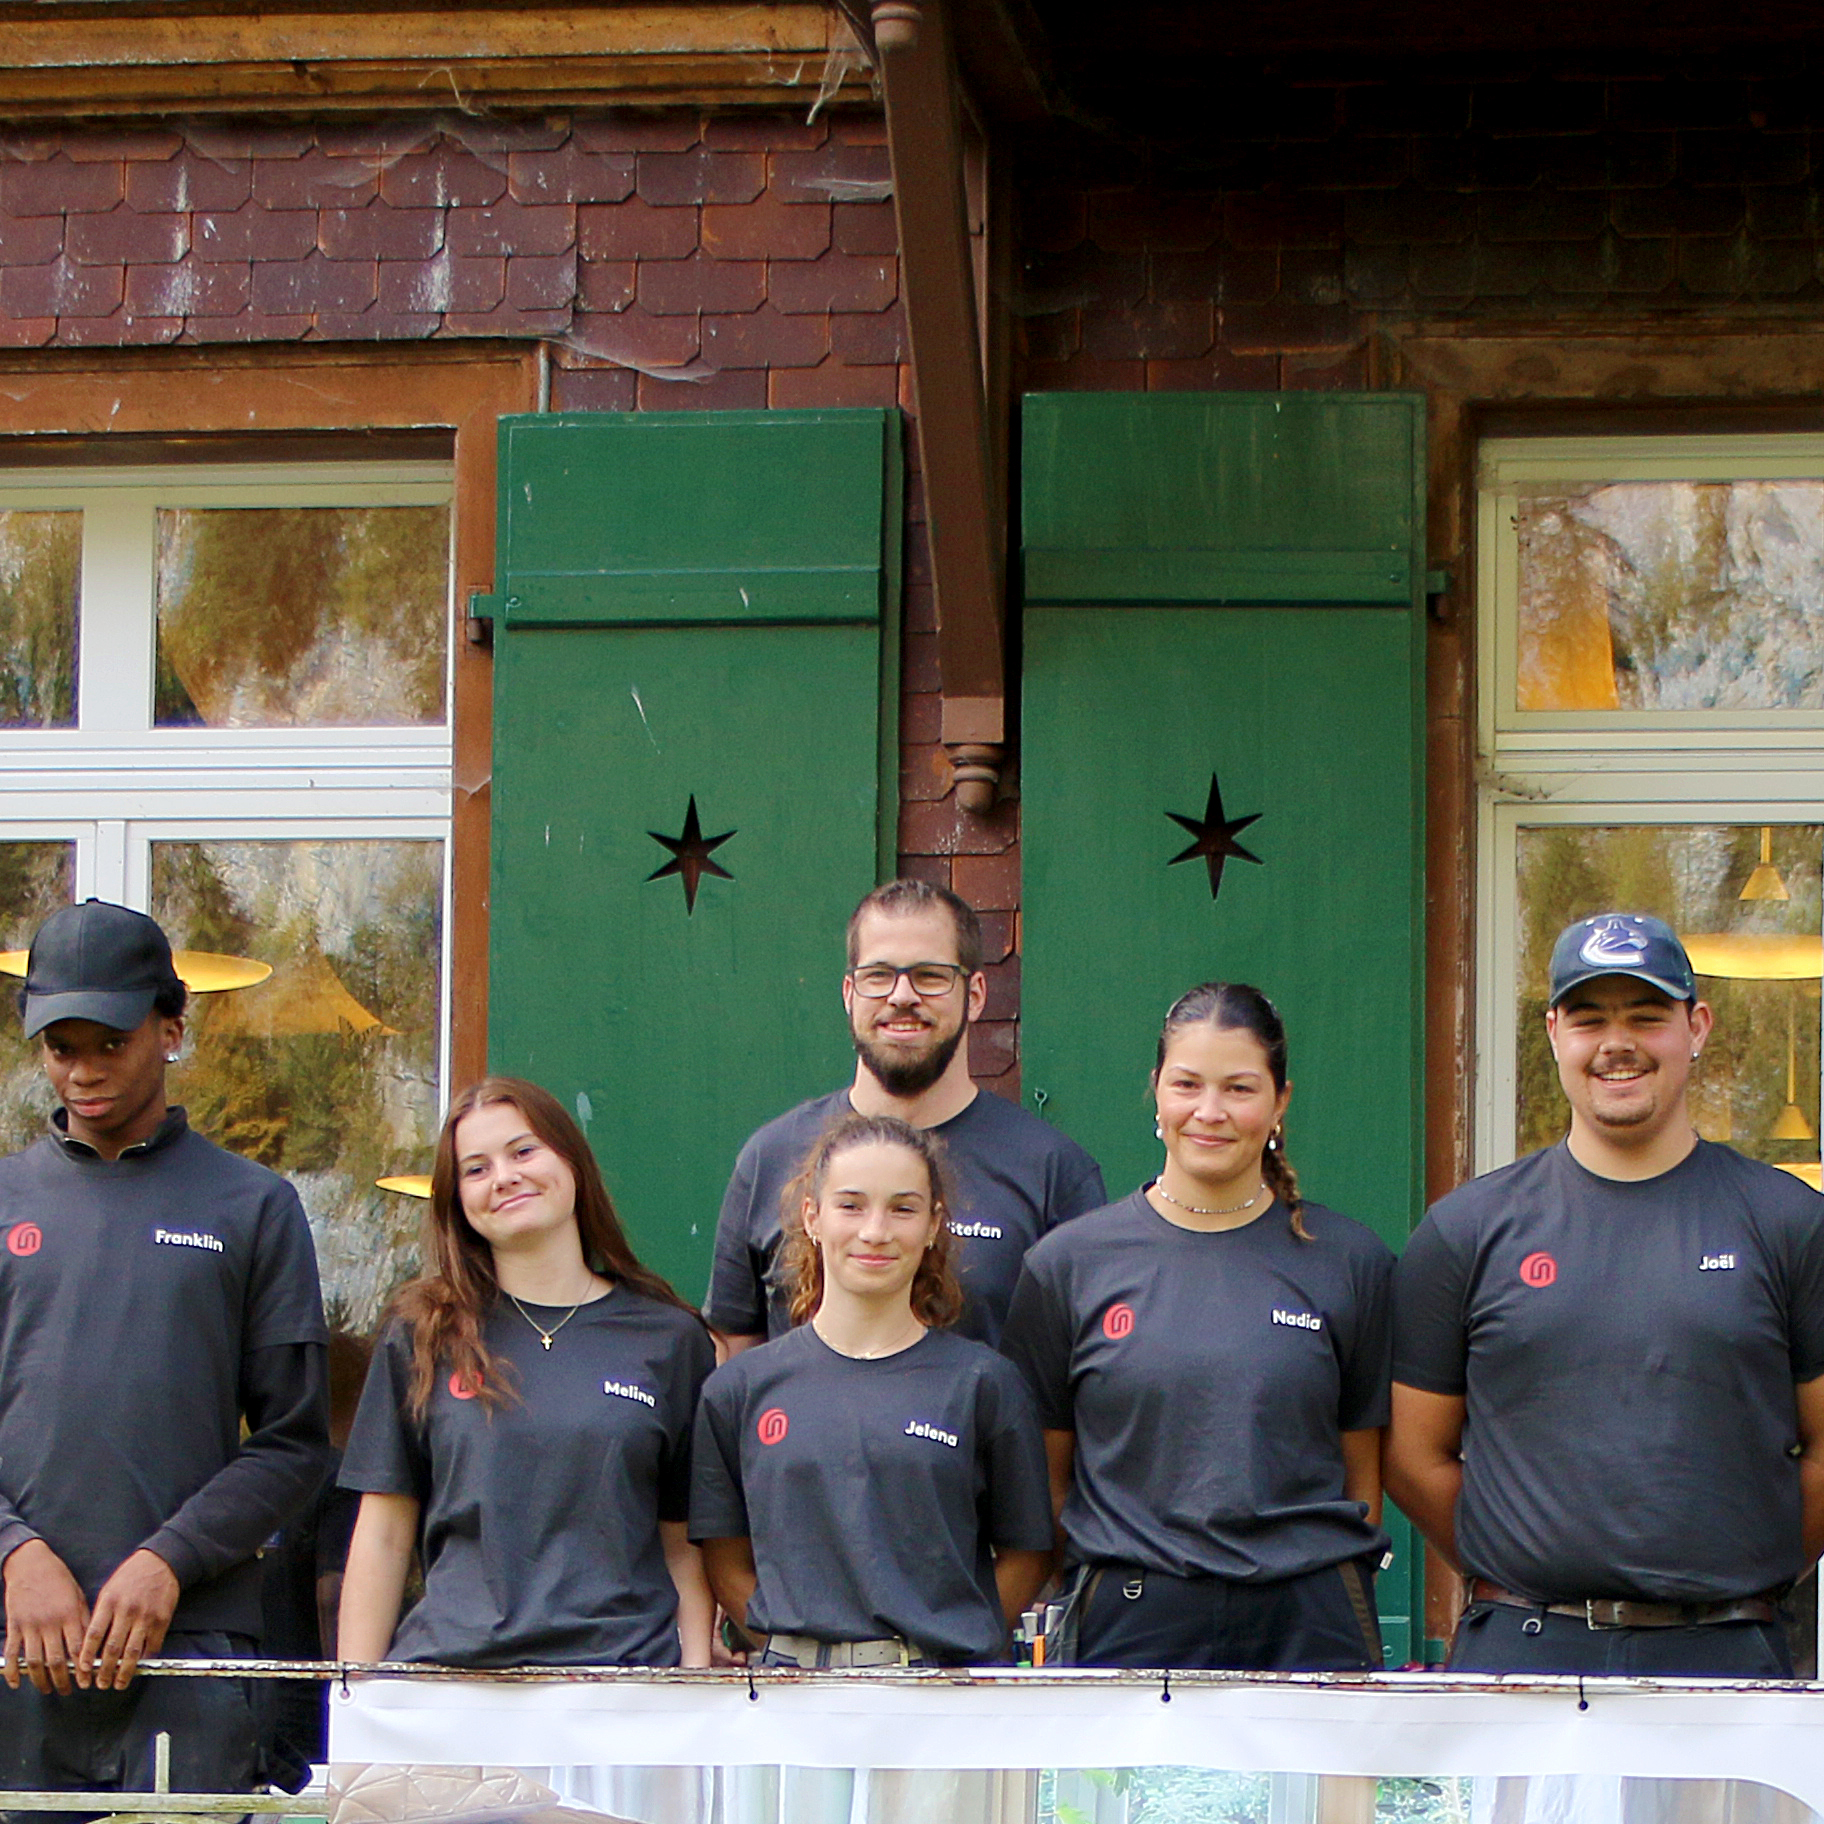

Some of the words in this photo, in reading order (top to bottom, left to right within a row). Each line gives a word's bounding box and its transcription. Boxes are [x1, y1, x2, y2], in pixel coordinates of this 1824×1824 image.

[154, 1229, 224, 1254] Franklin
[1698, 1254, 1735, 1272] Joël
[1271, 1308, 1322, 1332] Nadia
[603, 1380, 656, 1409] Melina
[904, 1420, 959, 1448] Jelena
